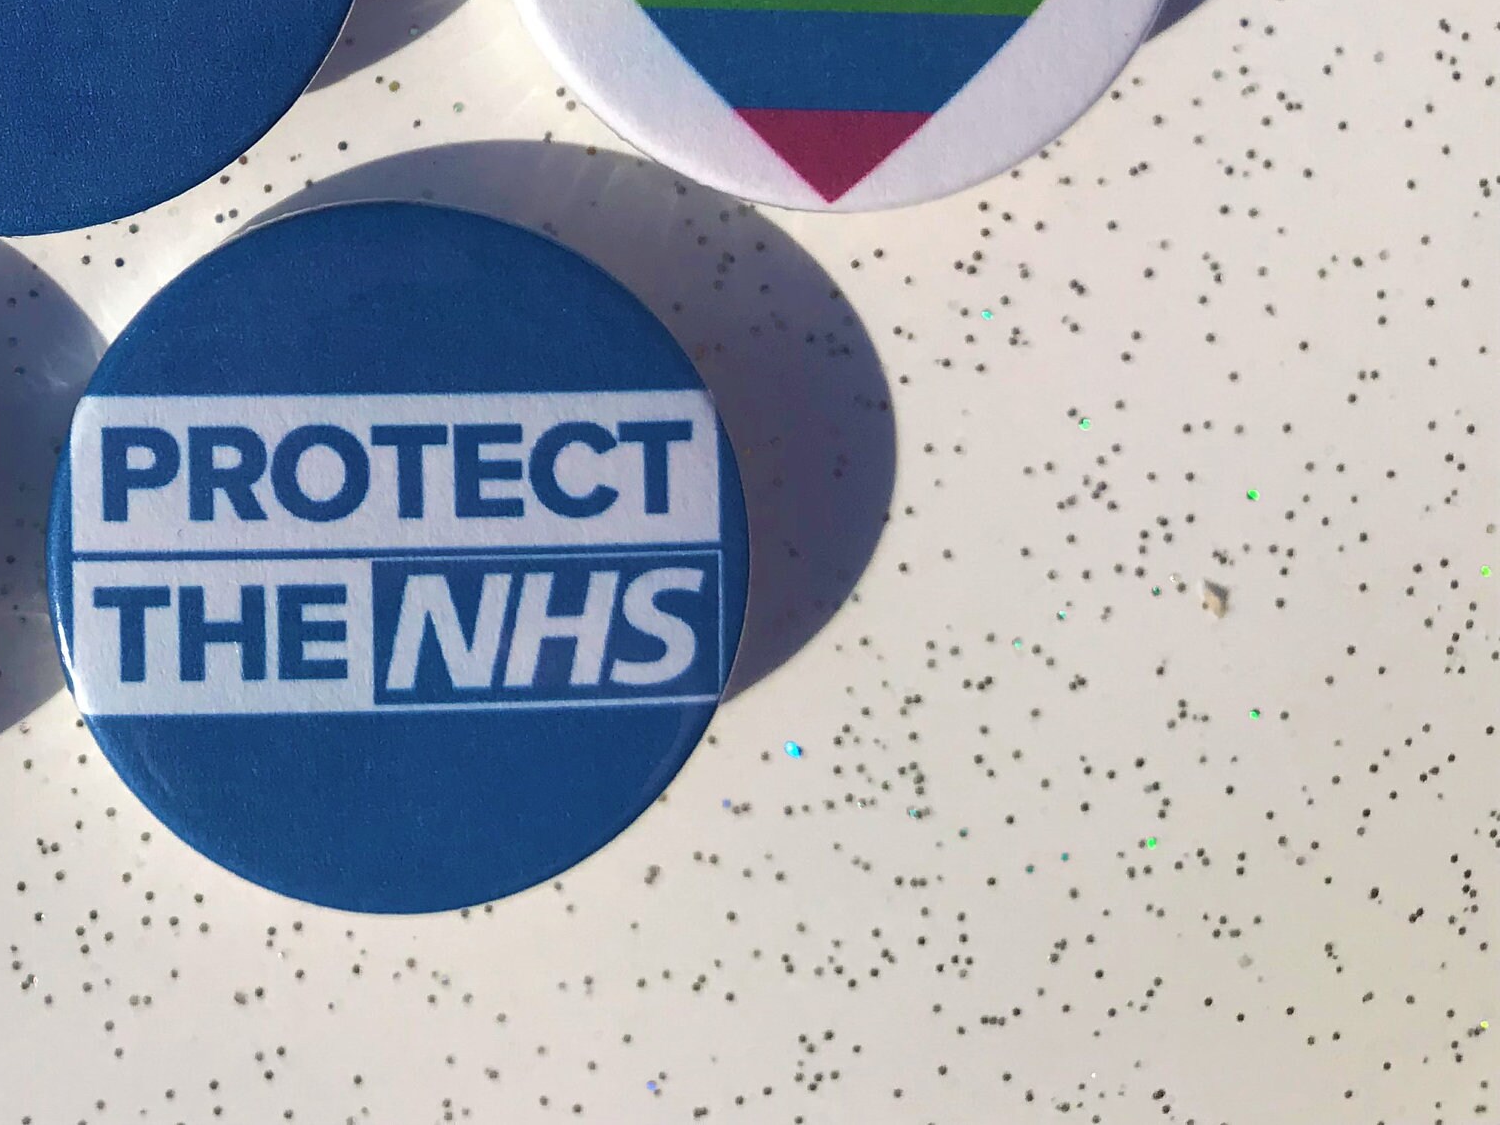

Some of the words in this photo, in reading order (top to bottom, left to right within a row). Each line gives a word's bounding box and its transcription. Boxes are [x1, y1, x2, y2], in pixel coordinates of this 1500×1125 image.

[100, 420, 693, 522] PROTECT
[92, 583, 348, 683] THE
[384, 568, 705, 691] NHS
